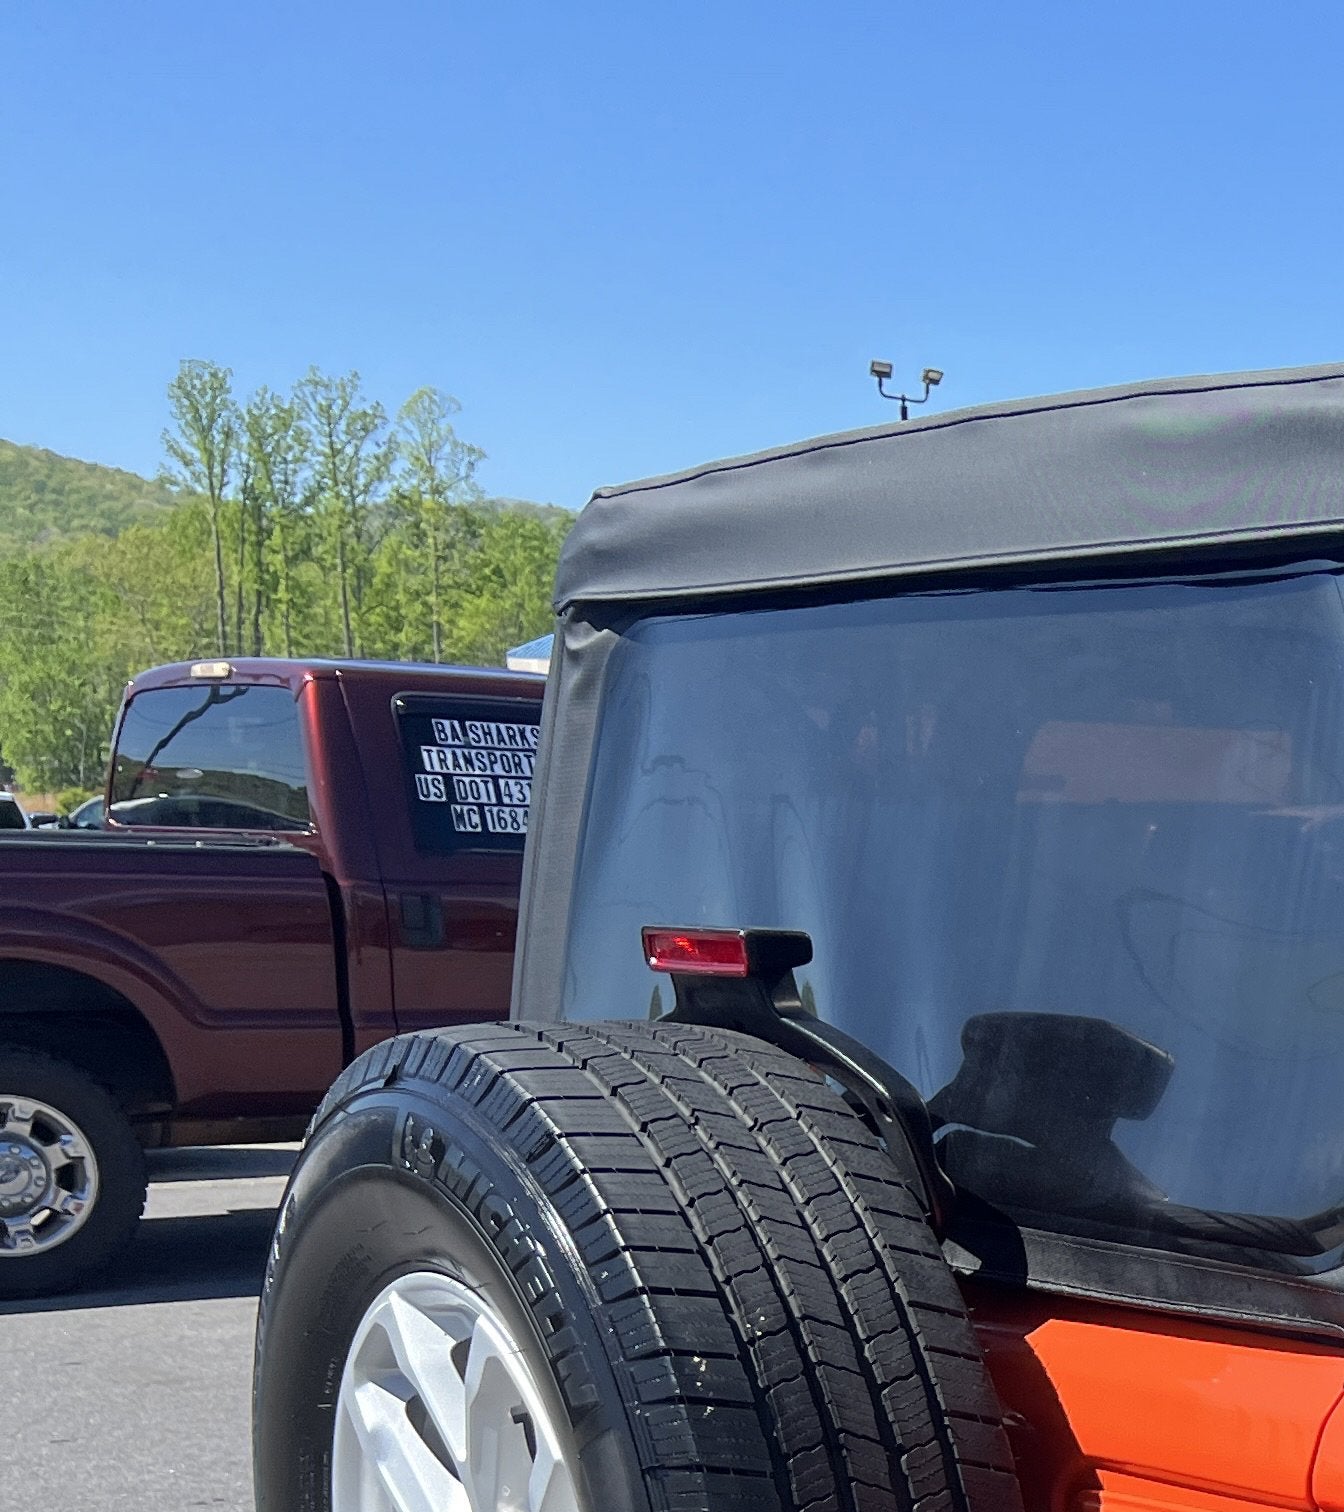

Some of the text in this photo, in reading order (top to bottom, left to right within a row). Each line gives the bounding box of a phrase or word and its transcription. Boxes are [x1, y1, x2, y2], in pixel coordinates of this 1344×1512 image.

[434, 721, 462, 743] BA
[423, 748, 534, 775] TRANSPORT
[417, 776, 444, 799] US
[456, 779, 494, 803] DOT
[453, 807, 480, 831] MC
[435, 1144, 601, 1412] MICHELIN
